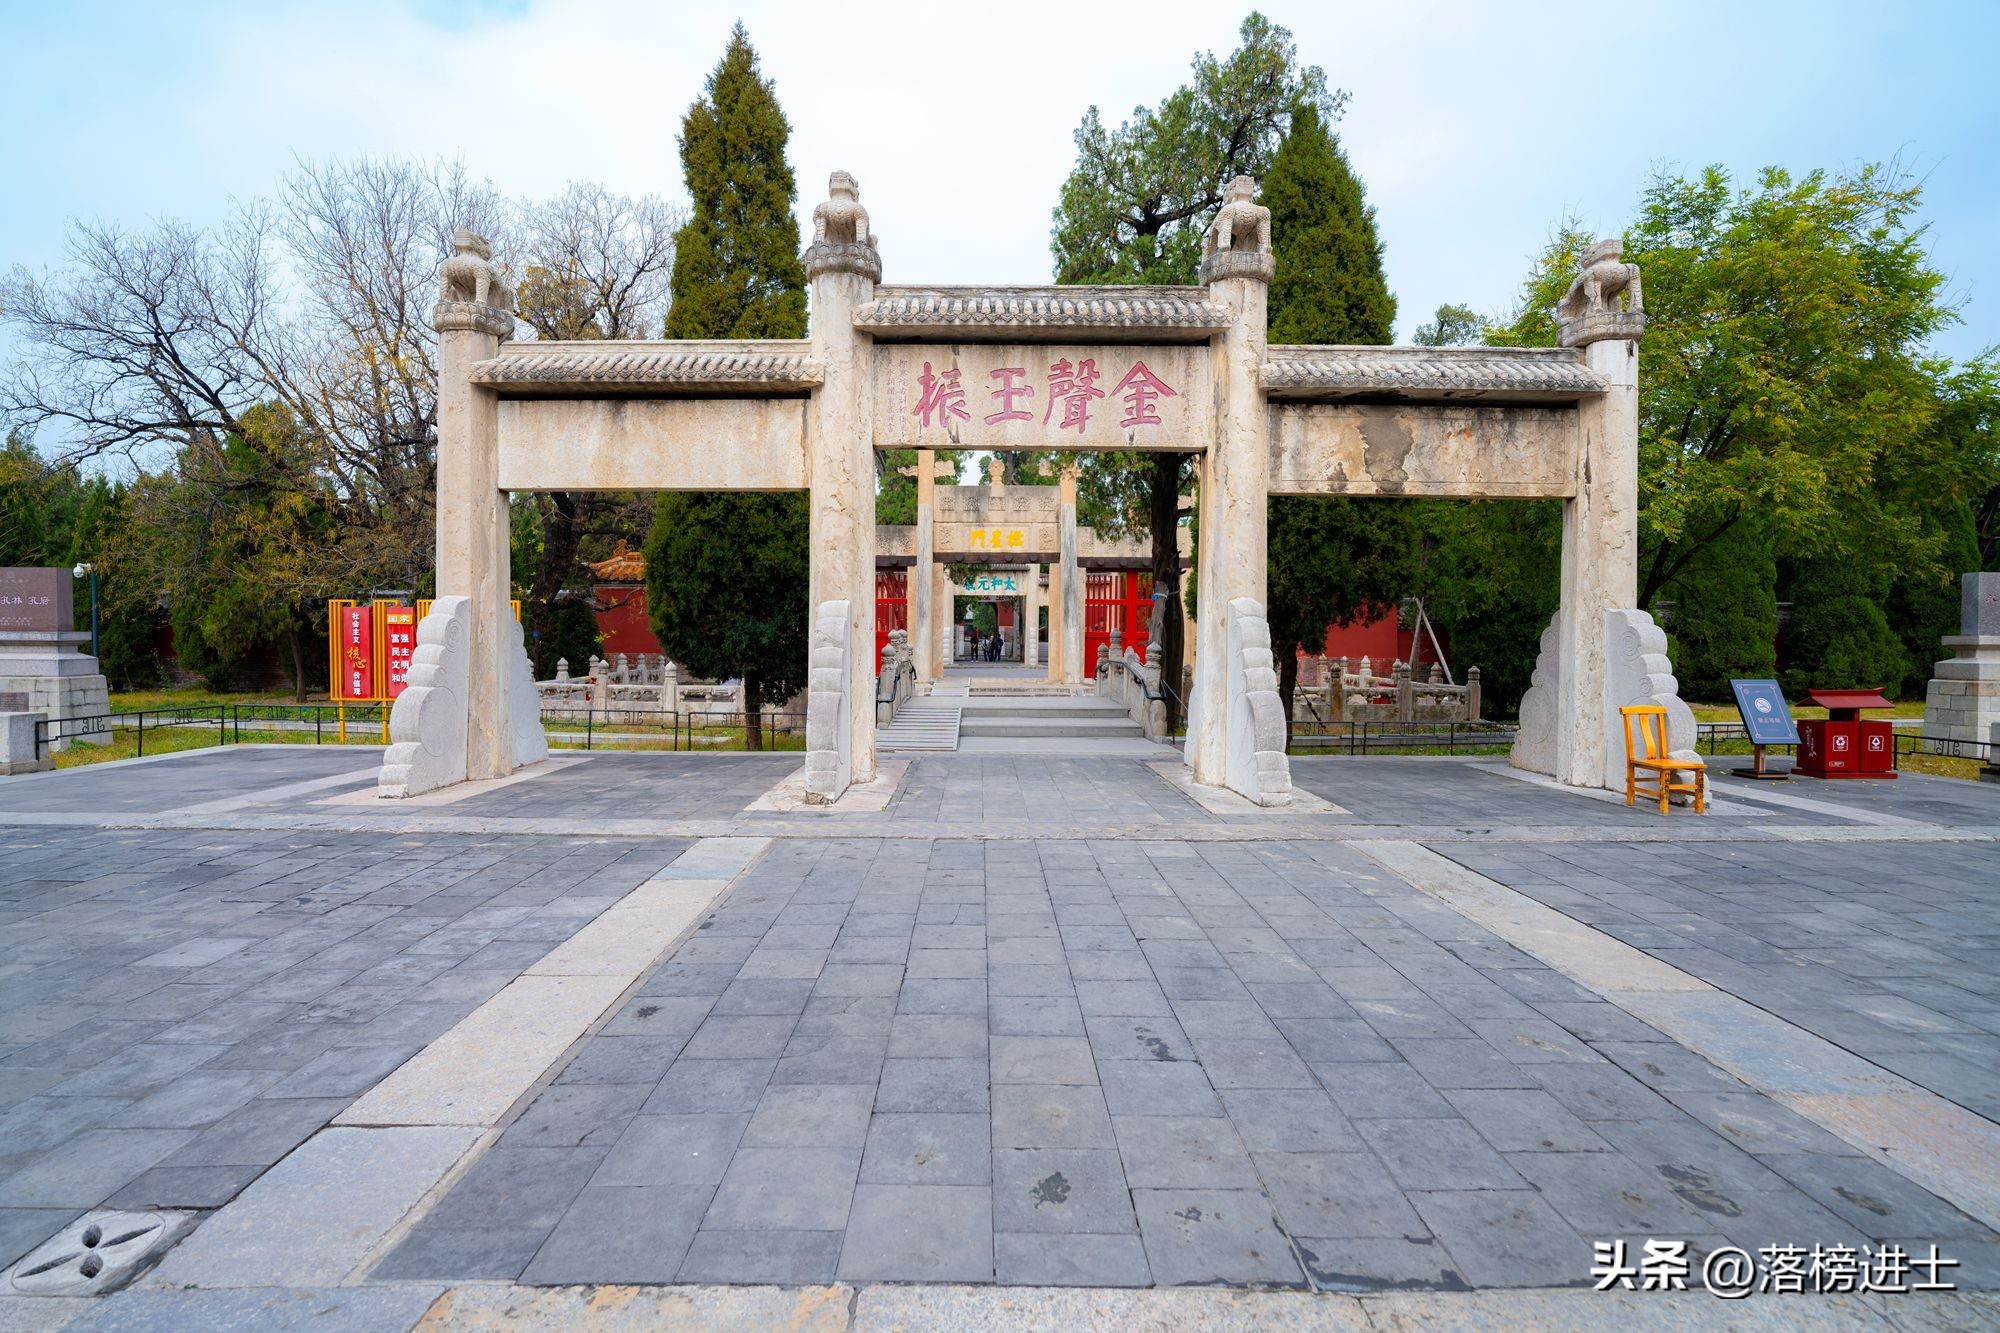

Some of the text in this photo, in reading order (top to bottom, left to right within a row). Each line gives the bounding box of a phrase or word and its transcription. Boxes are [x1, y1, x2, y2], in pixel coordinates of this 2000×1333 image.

[391, 634, 410, 643] 富强
[391, 647, 410, 656] 民主
[391, 661, 410, 670] 文明
